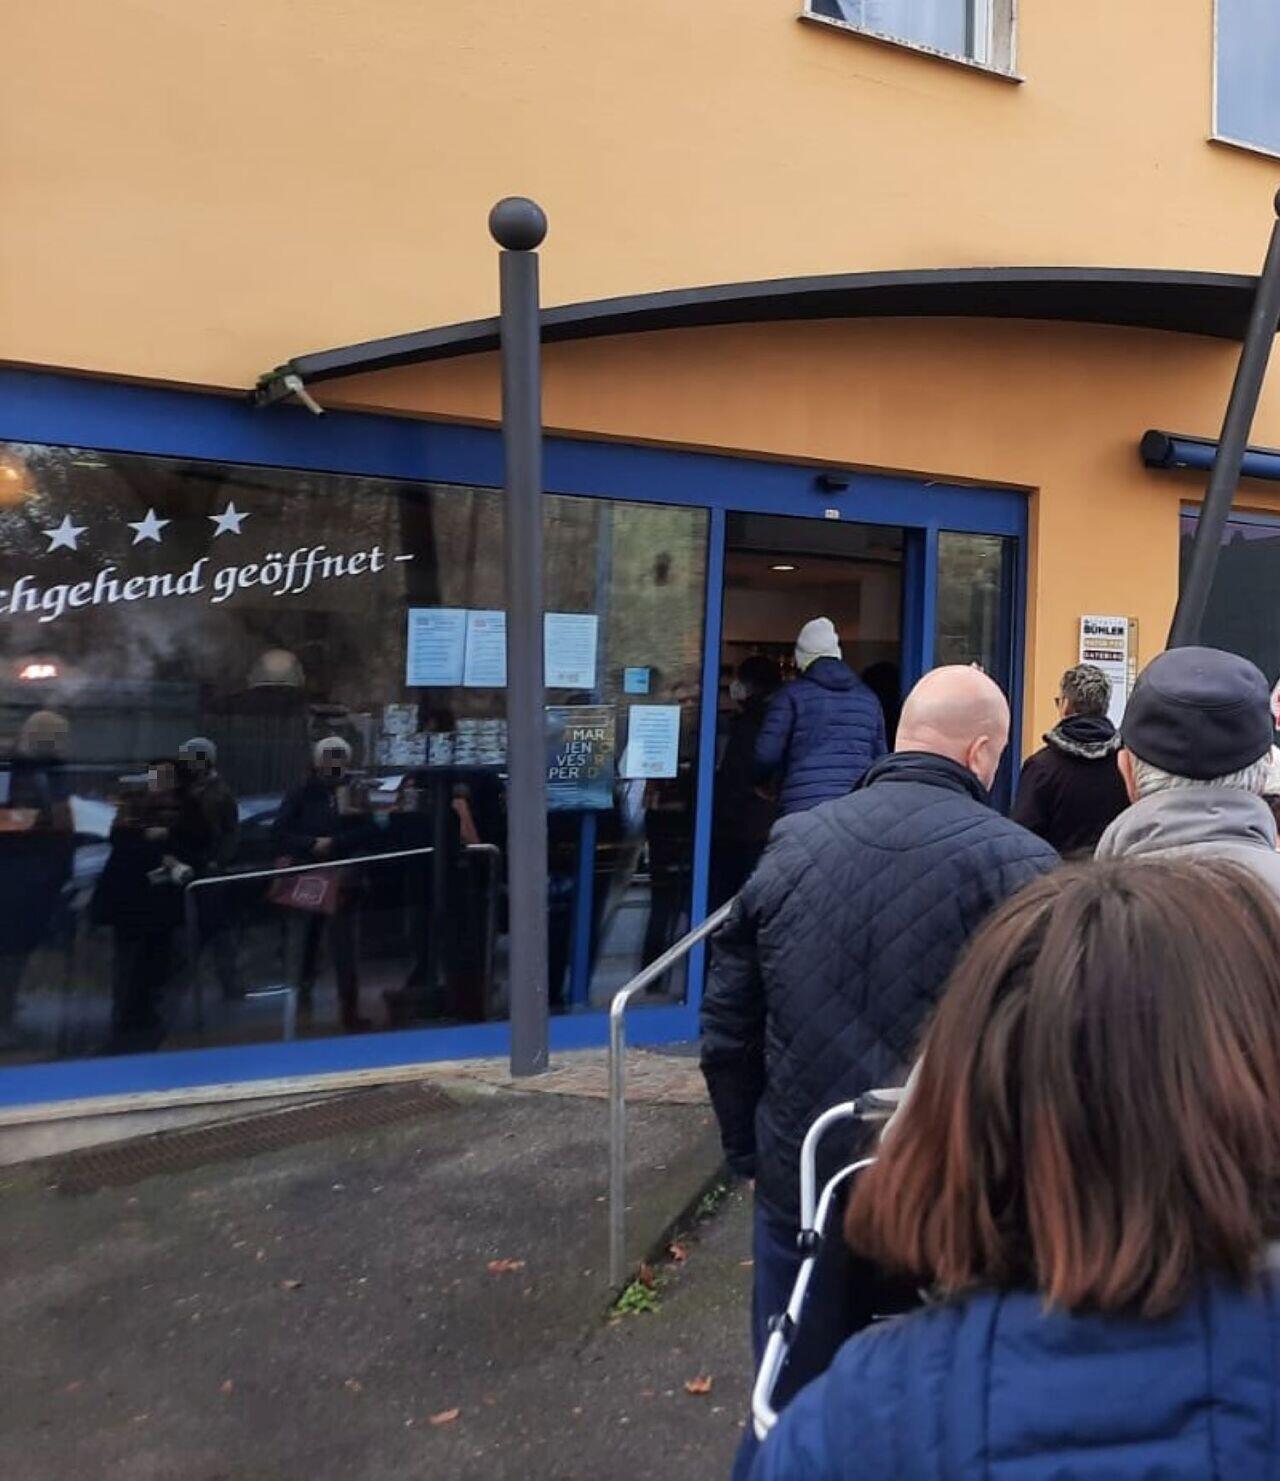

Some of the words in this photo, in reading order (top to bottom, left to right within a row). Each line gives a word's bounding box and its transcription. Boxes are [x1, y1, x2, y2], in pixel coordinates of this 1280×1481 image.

[211, 545, 385, 603] geöffnet
[573, 728, 605, 741] MAR
[565, 741, 592, 754] IEN
[556, 754, 586, 767] VES
[549, 767, 579, 780] PER
